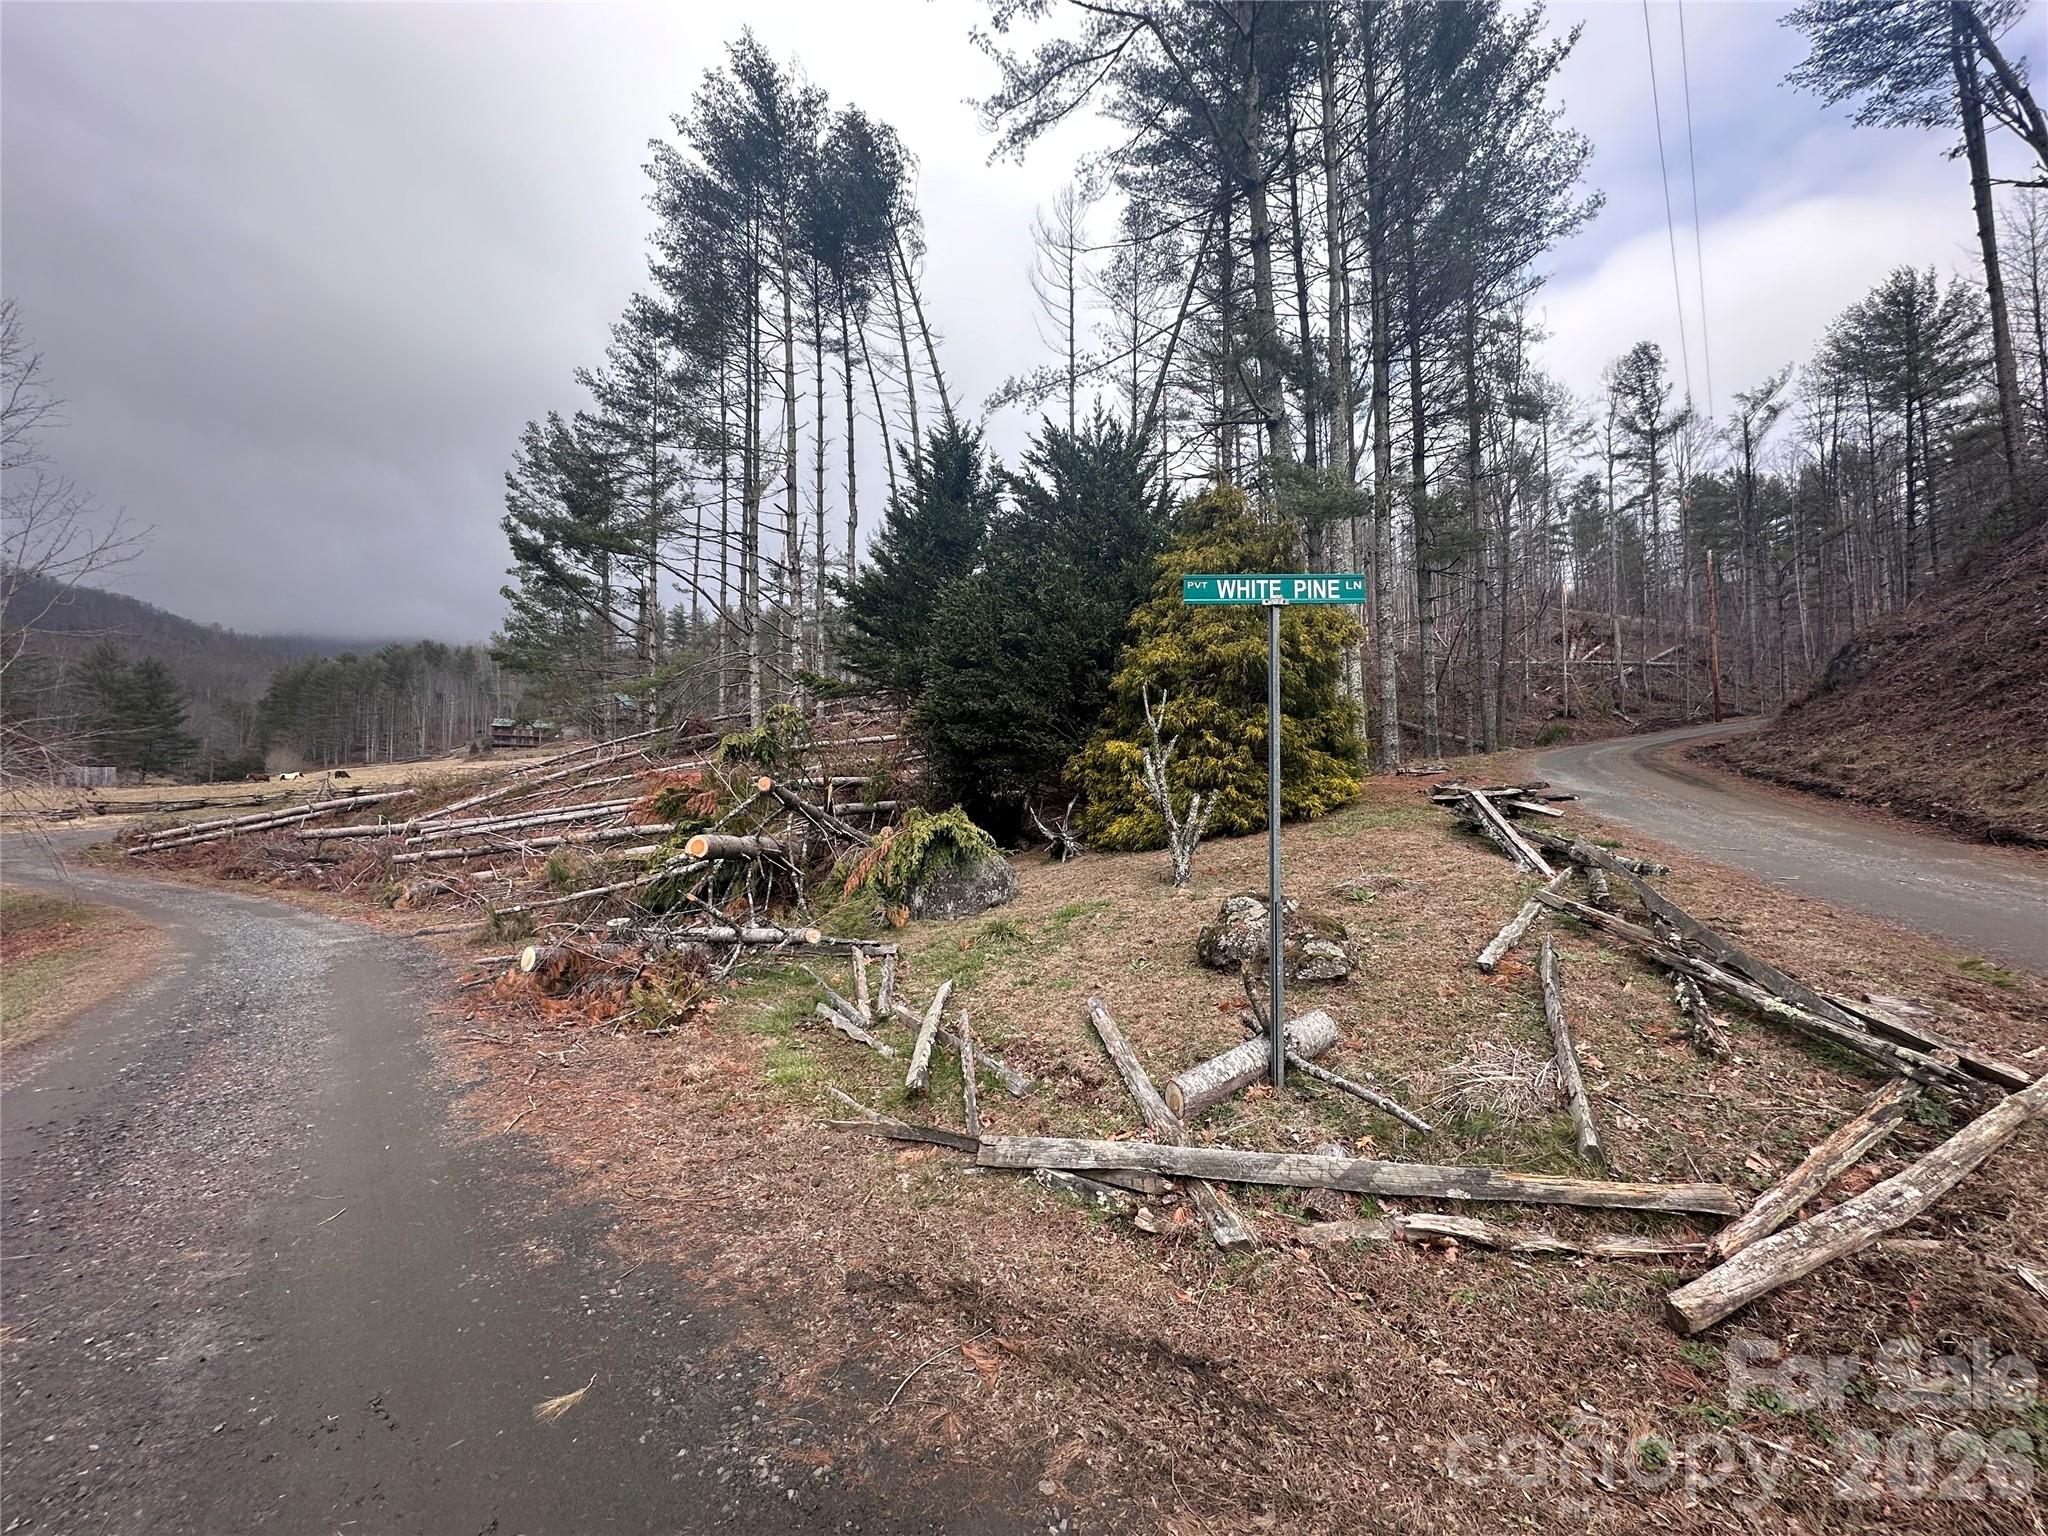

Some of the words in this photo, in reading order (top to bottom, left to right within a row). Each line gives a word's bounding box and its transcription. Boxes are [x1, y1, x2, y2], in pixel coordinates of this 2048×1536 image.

[1187, 581, 1208, 589] PVT
[1216, 579, 1281, 599] WHITE
[1294, 579, 1340, 599] PINE
[1345, 581, 1362, 590] LN
